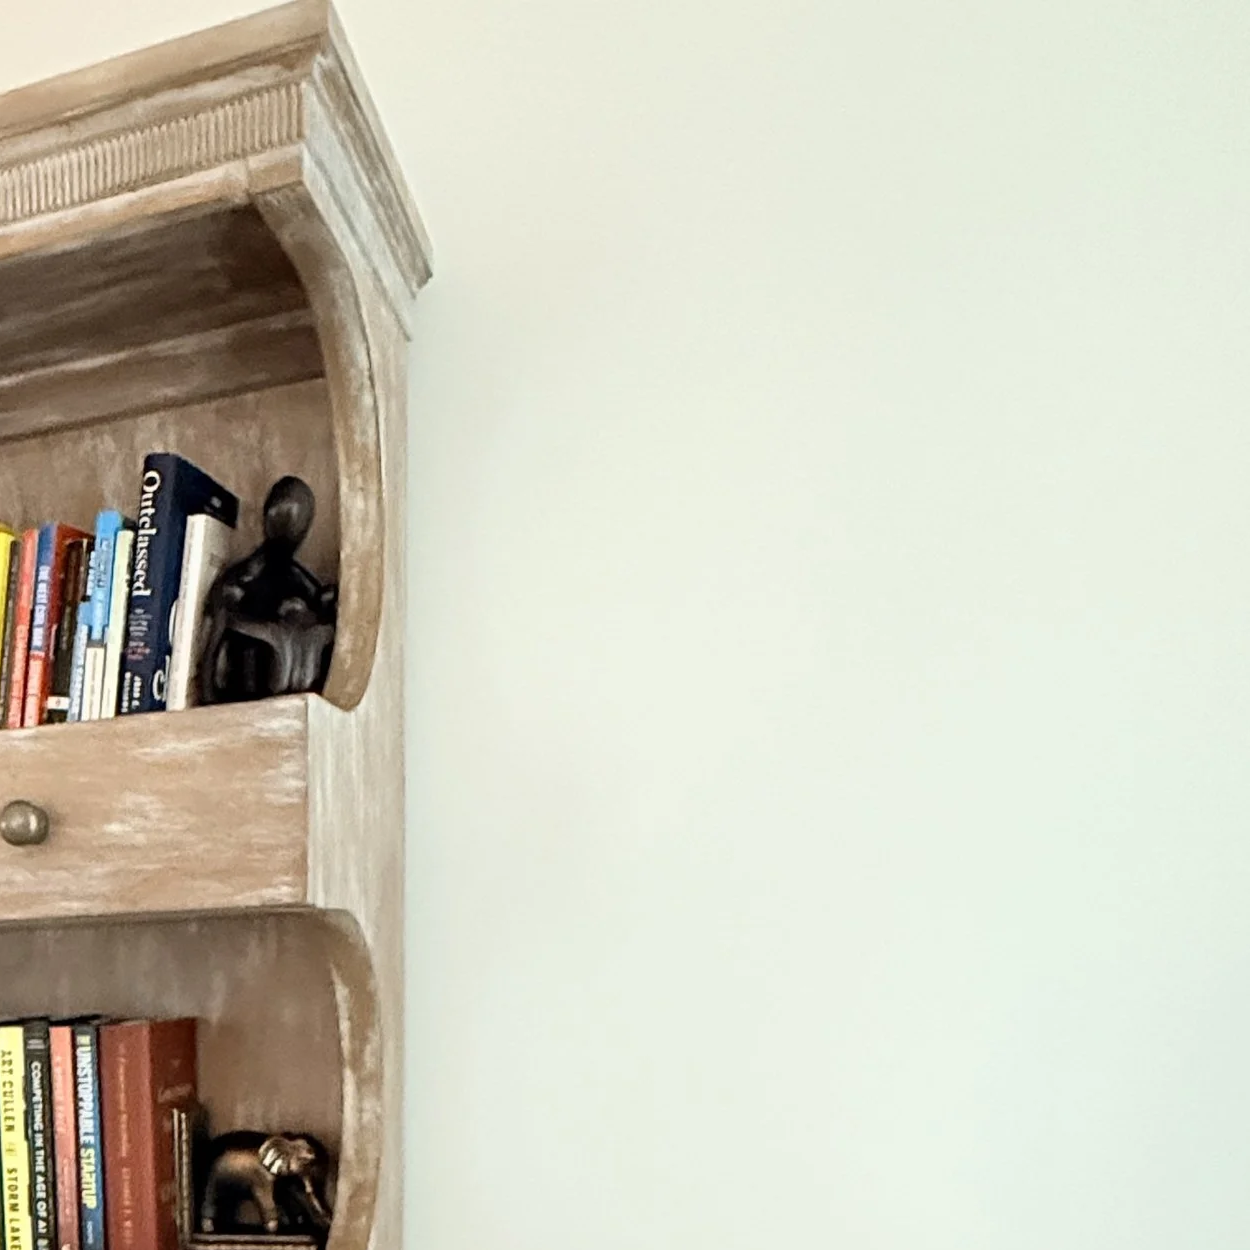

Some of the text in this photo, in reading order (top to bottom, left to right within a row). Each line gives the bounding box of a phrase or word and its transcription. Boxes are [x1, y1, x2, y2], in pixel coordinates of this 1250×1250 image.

[131, 470, 161, 597] Outclassed
[31, 1061, 44, 1131] COMPETING
[76, 1045, 96, 1144] UNSTOPPABLE
[1, 1050, 21, 1250] ART CULLEN STORM LAKE
[34, 1134, 42, 1146] IN
[34, 1150, 45, 1172] THE
[35, 1175, 46, 1199] AGE
[37, 1202, 46, 1217] OF
[80, 1147, 98, 1210] STARTUP
